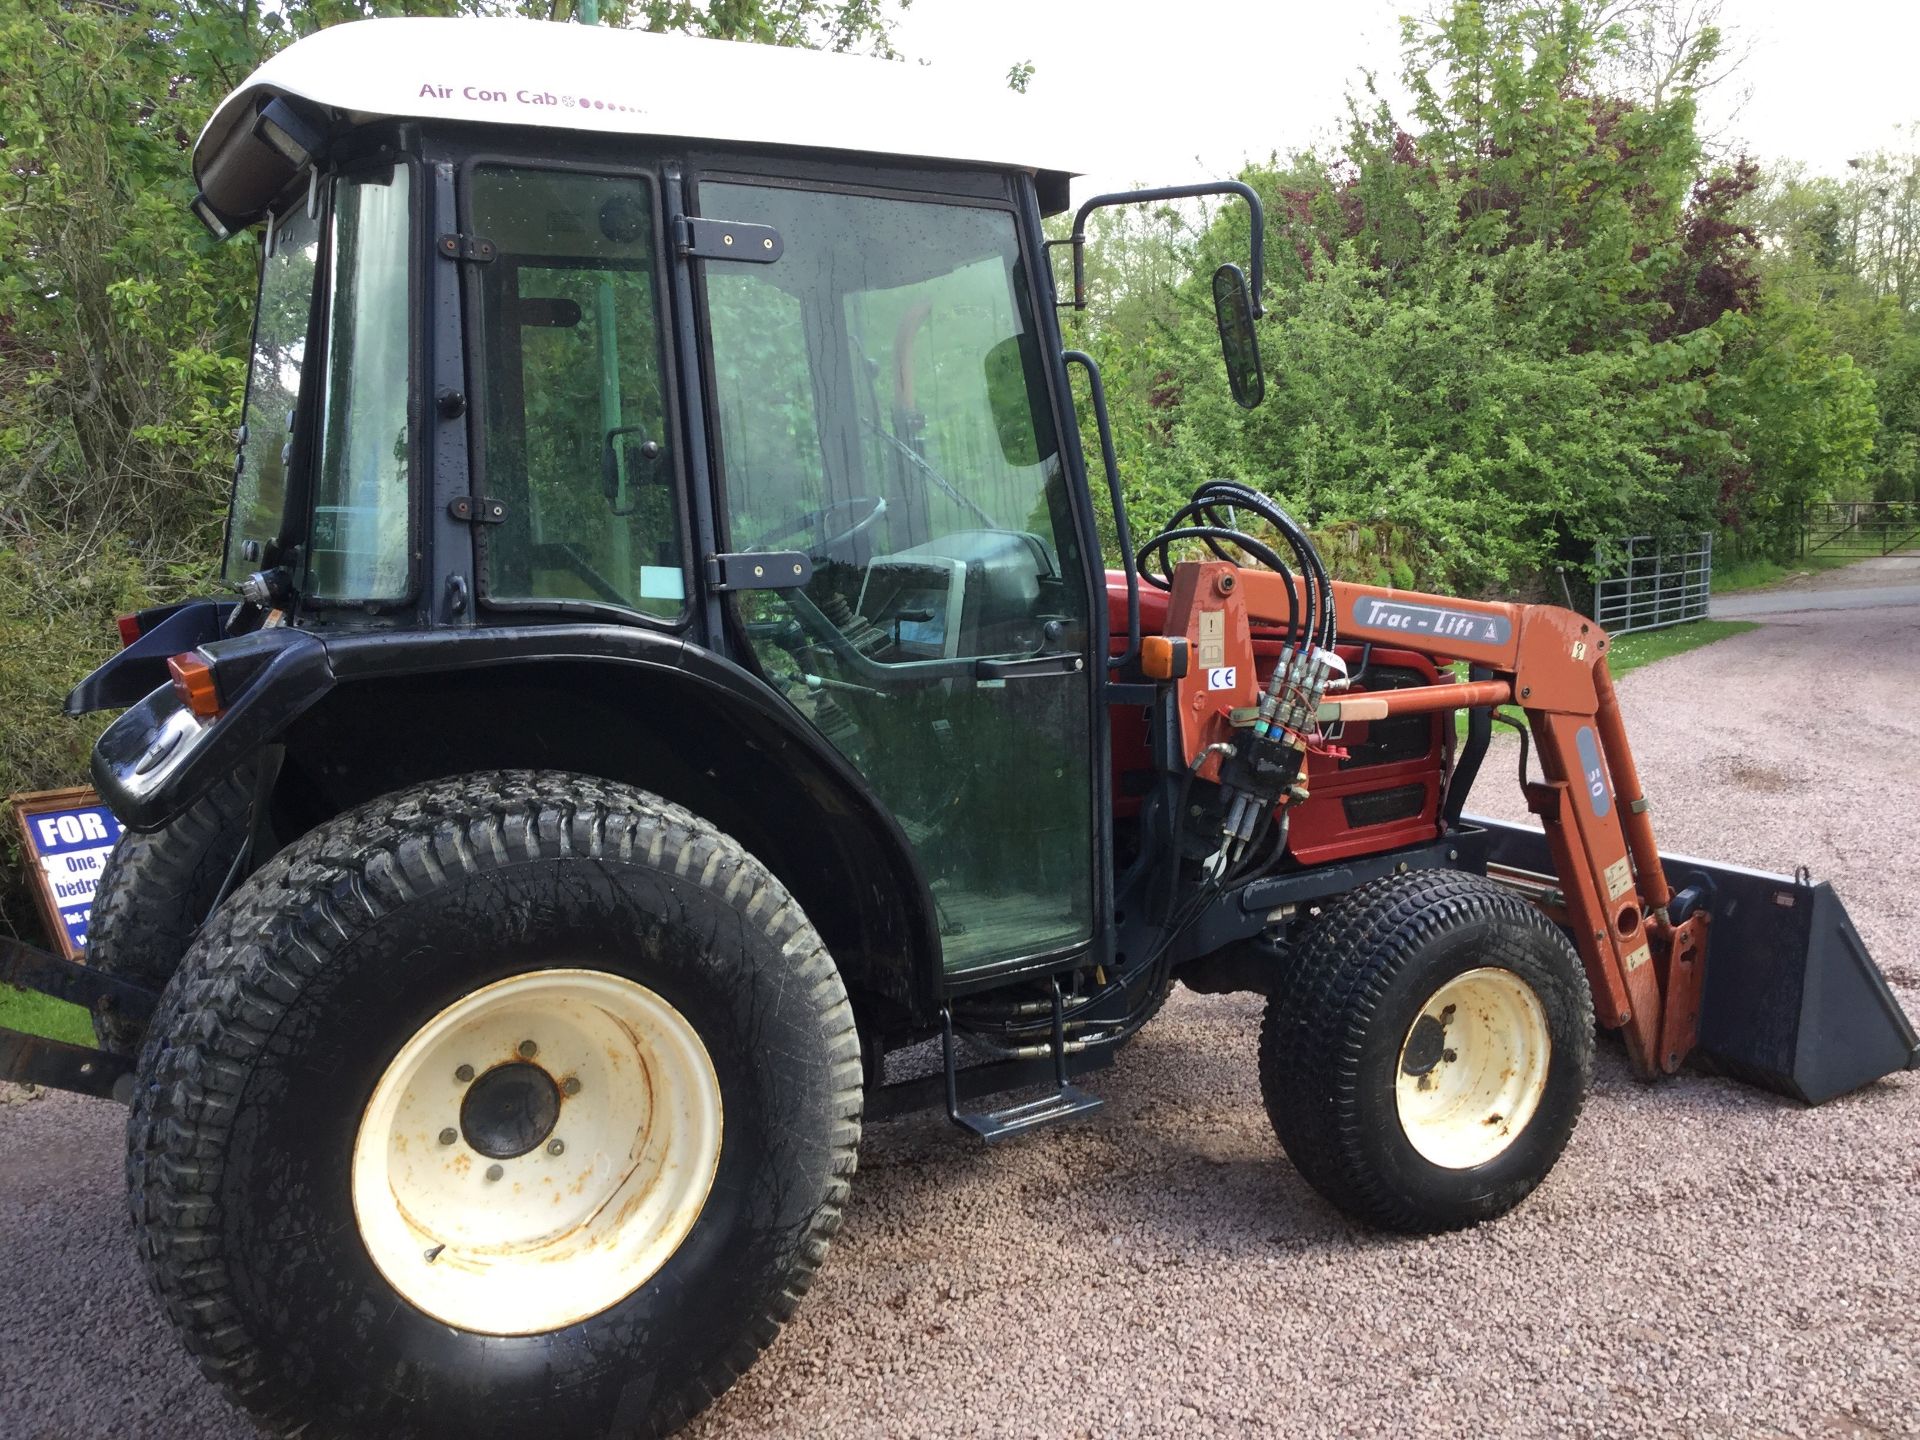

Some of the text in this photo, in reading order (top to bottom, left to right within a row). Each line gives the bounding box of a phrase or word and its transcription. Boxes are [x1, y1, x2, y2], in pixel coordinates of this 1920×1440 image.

[418, 84, 558, 106] Air Con Cab
[1367, 601, 1412, 629] Trac
[1433, 610, 1474, 636] Lift
[1211, 668, 1234, 688] CE
[37, 813, 108, 847] FOR
[66, 855, 101, 872] One,
